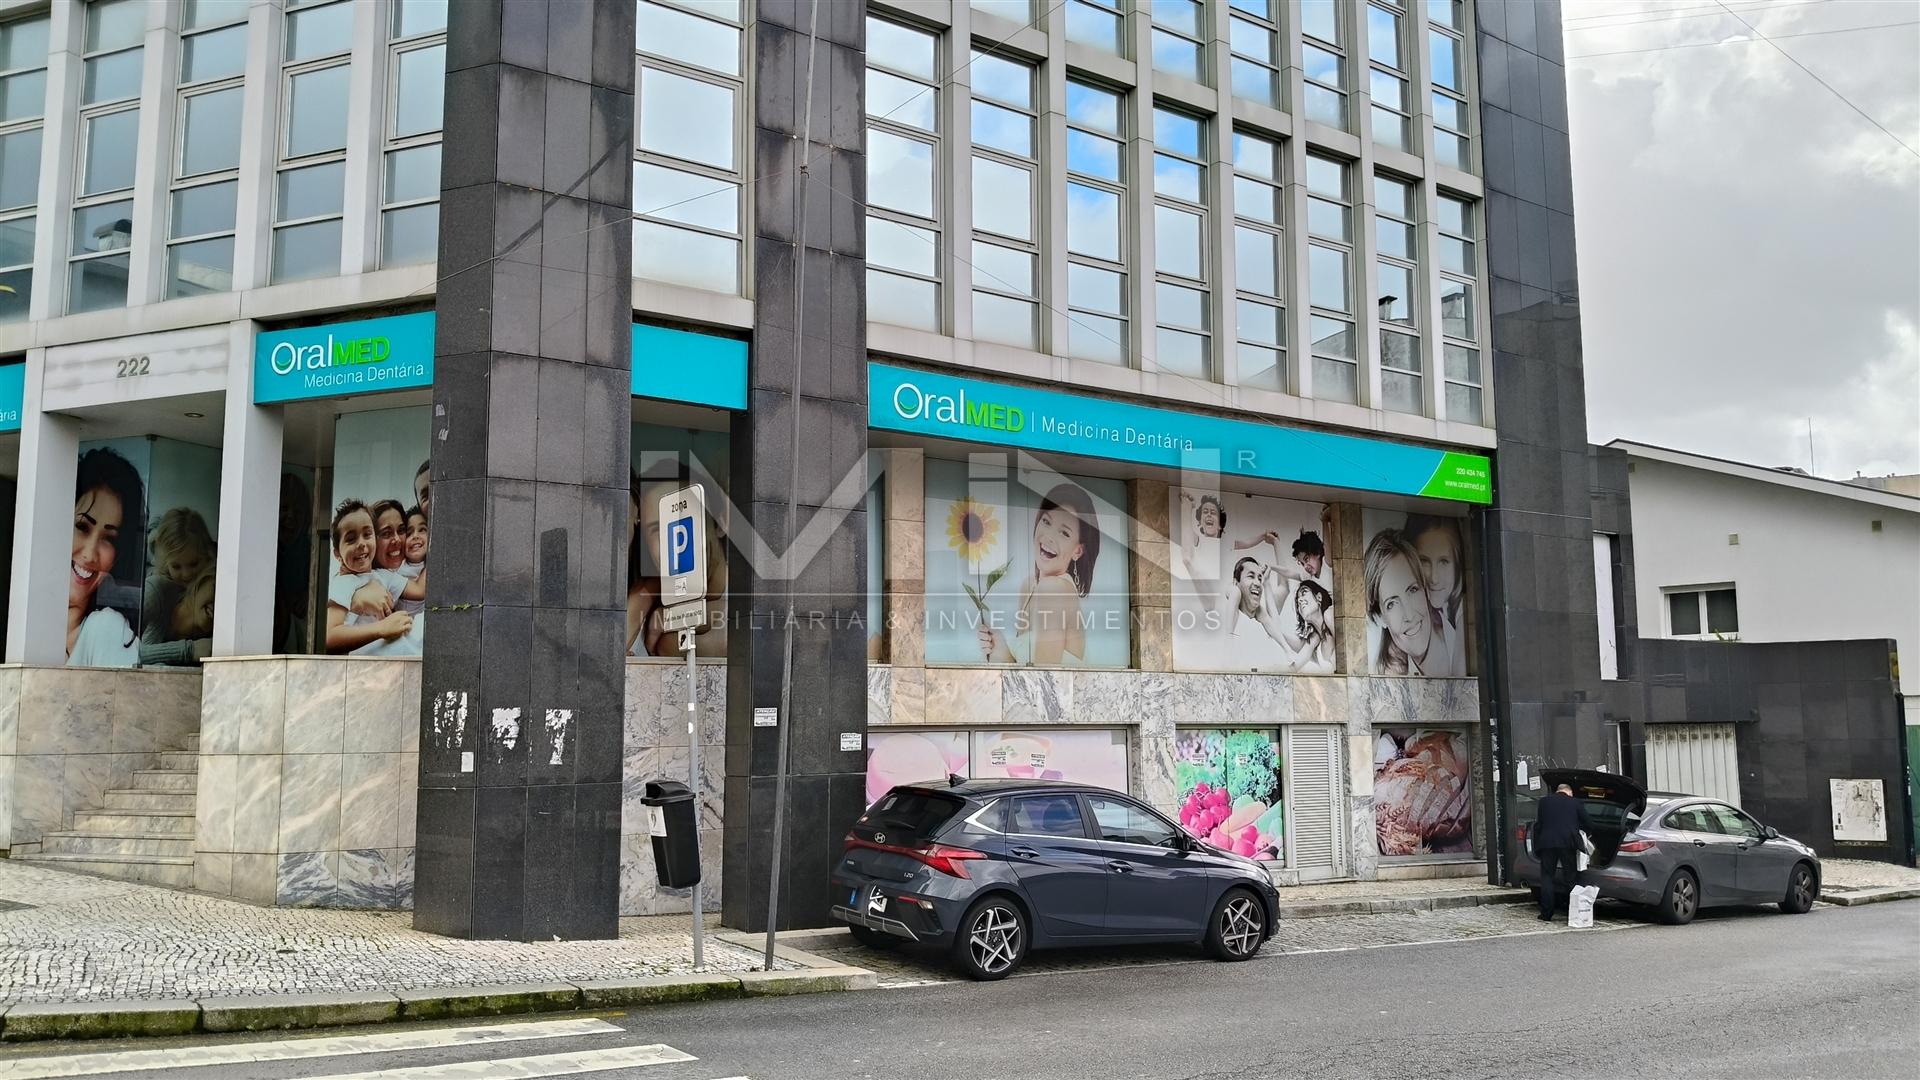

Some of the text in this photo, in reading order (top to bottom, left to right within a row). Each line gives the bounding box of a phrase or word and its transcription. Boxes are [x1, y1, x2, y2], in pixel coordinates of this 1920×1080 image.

[117, 356, 150, 378] 222
[271, 334, 390, 375] OralMED
[304, 363, 424, 388] Medicina Dentária
[893, 383, 1025, 432] OralMED
[1041, 416, 1193, 452] Medicina Dentária
[671, 499, 688, 513] zona
[672, 525, 689, 570] P
